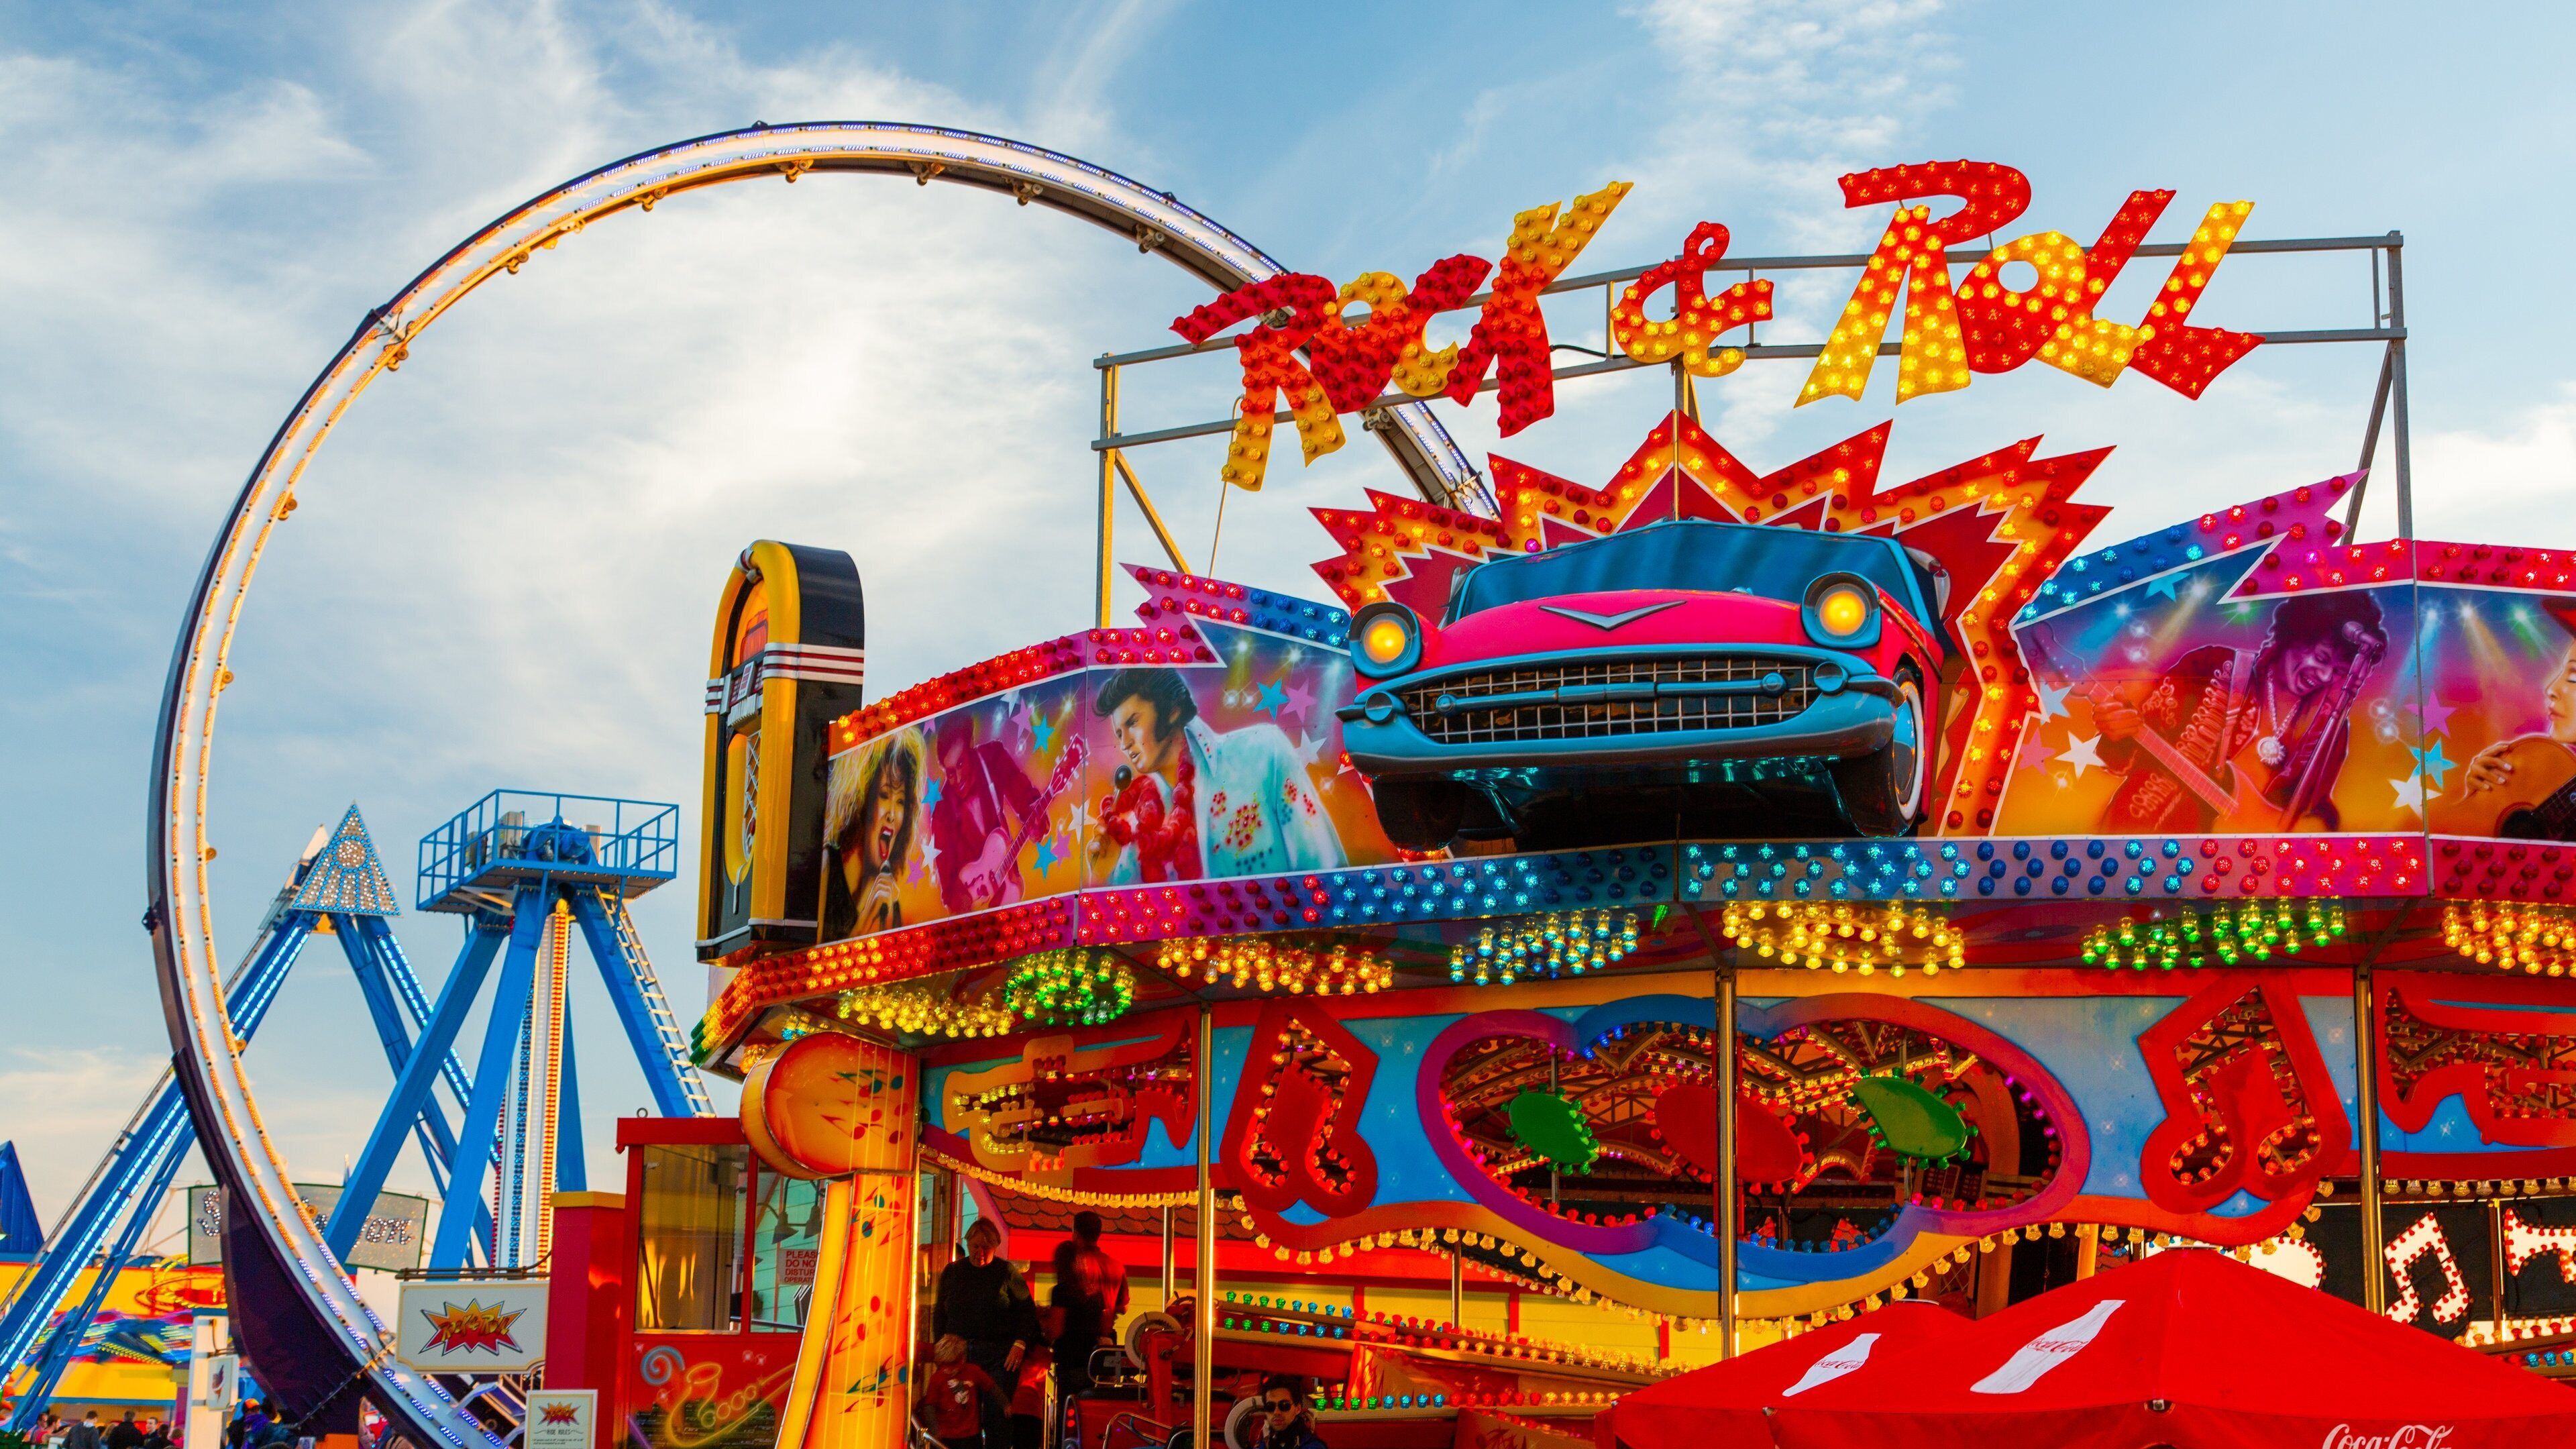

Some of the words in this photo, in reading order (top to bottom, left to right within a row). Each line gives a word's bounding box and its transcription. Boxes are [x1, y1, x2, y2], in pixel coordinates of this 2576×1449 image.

[1611, 221, 1773, 377] &
[786, 1250, 817, 1258] PLEAS
[786, 1259, 799, 1267] DO
[802, 1259, 816, 1267] NO
[2322, 1423, 2455, 1449] Coca-Cl
